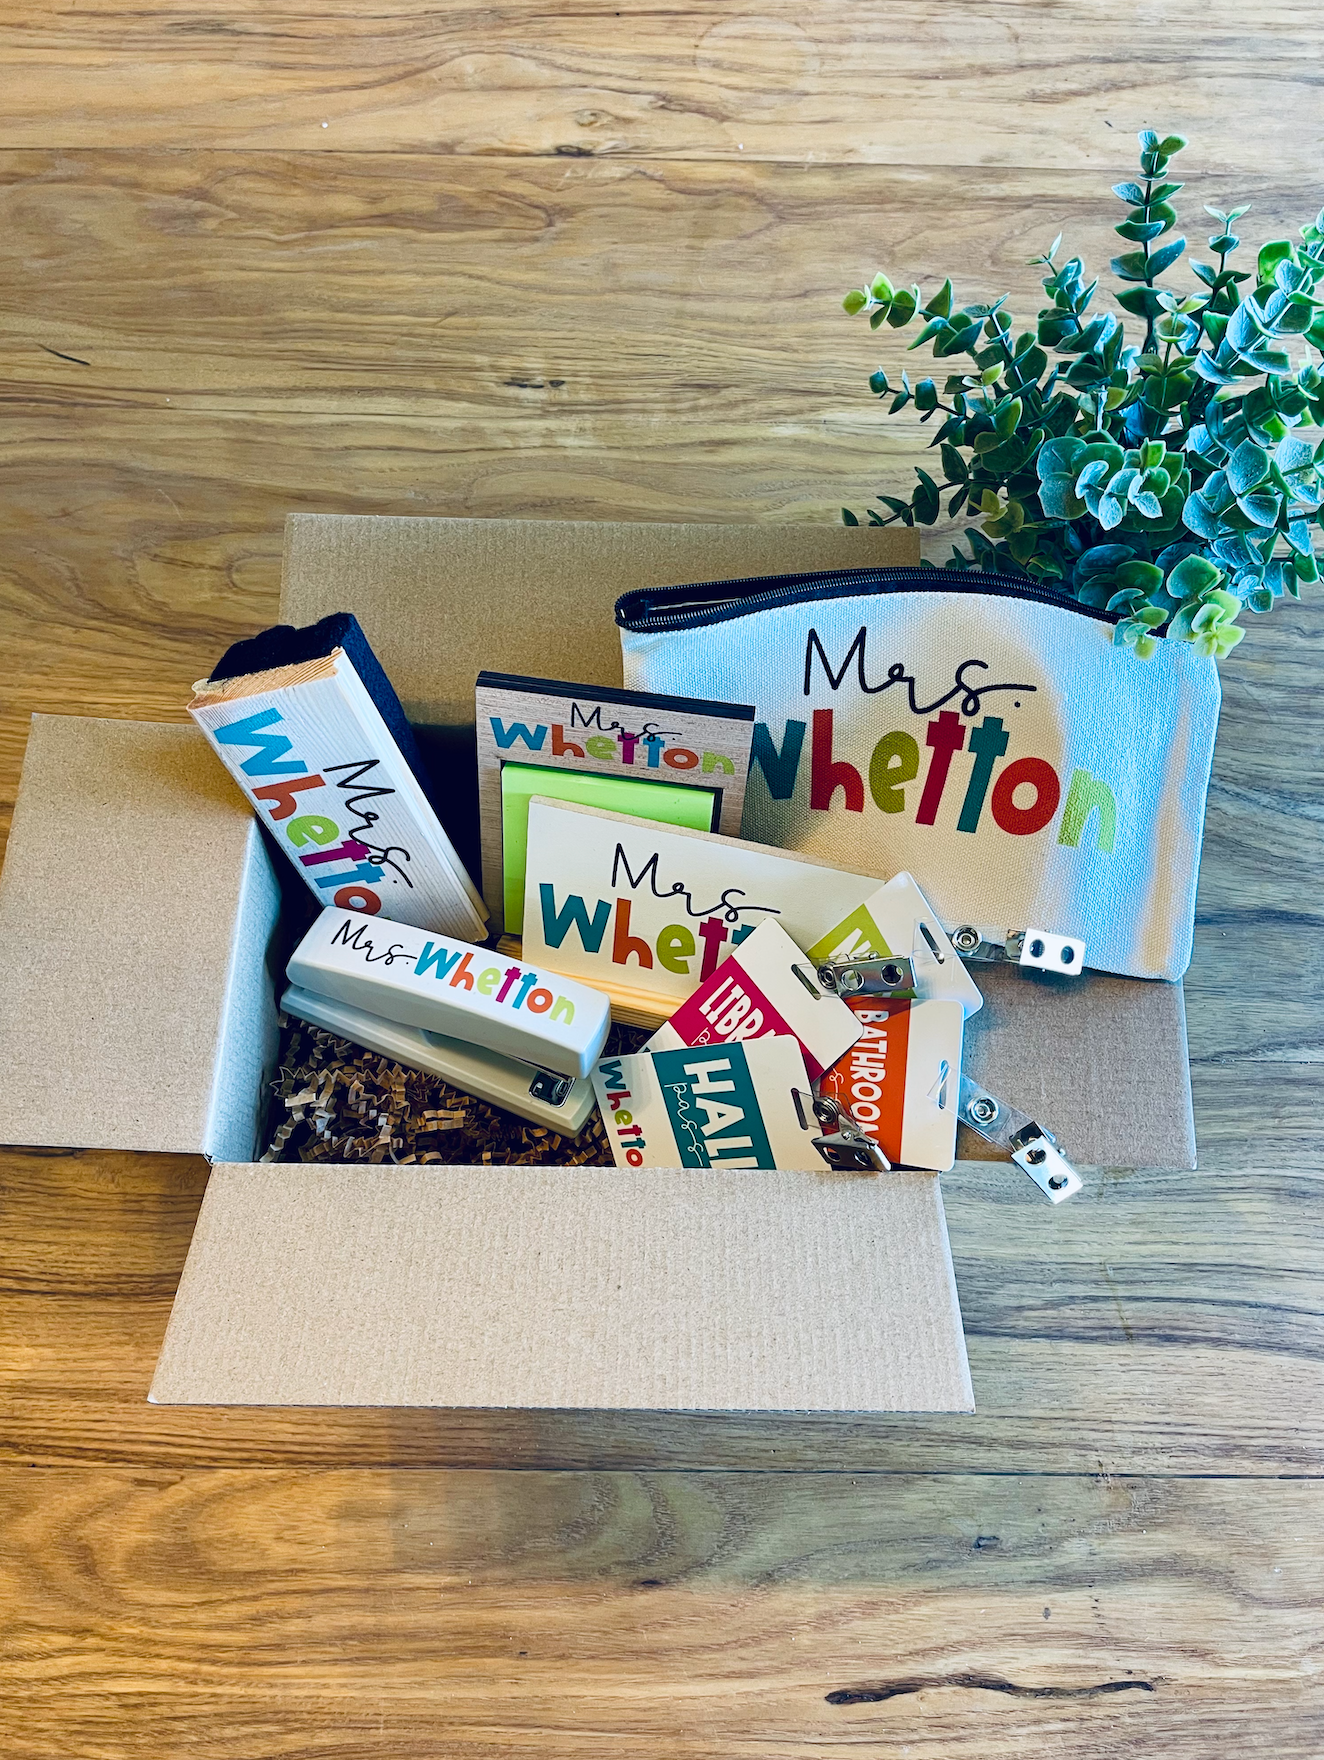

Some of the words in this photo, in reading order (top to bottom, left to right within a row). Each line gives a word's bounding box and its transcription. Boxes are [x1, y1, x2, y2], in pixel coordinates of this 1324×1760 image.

[804, 627, 1037, 716] Mrs.
[489, 717, 735, 776] Whetton
[570, 702, 682, 742] Mrs.
[213, 707, 391, 919] Whetto
[323, 759, 414, 888] Mrs.
[331, 919, 418, 966] Mrs.
[414, 941, 576, 1026] Whetton
[539, 883, 757, 983] Whet
[699, 975, 777, 1043] LIBR
[664, 1082, 704, 1167] pass
